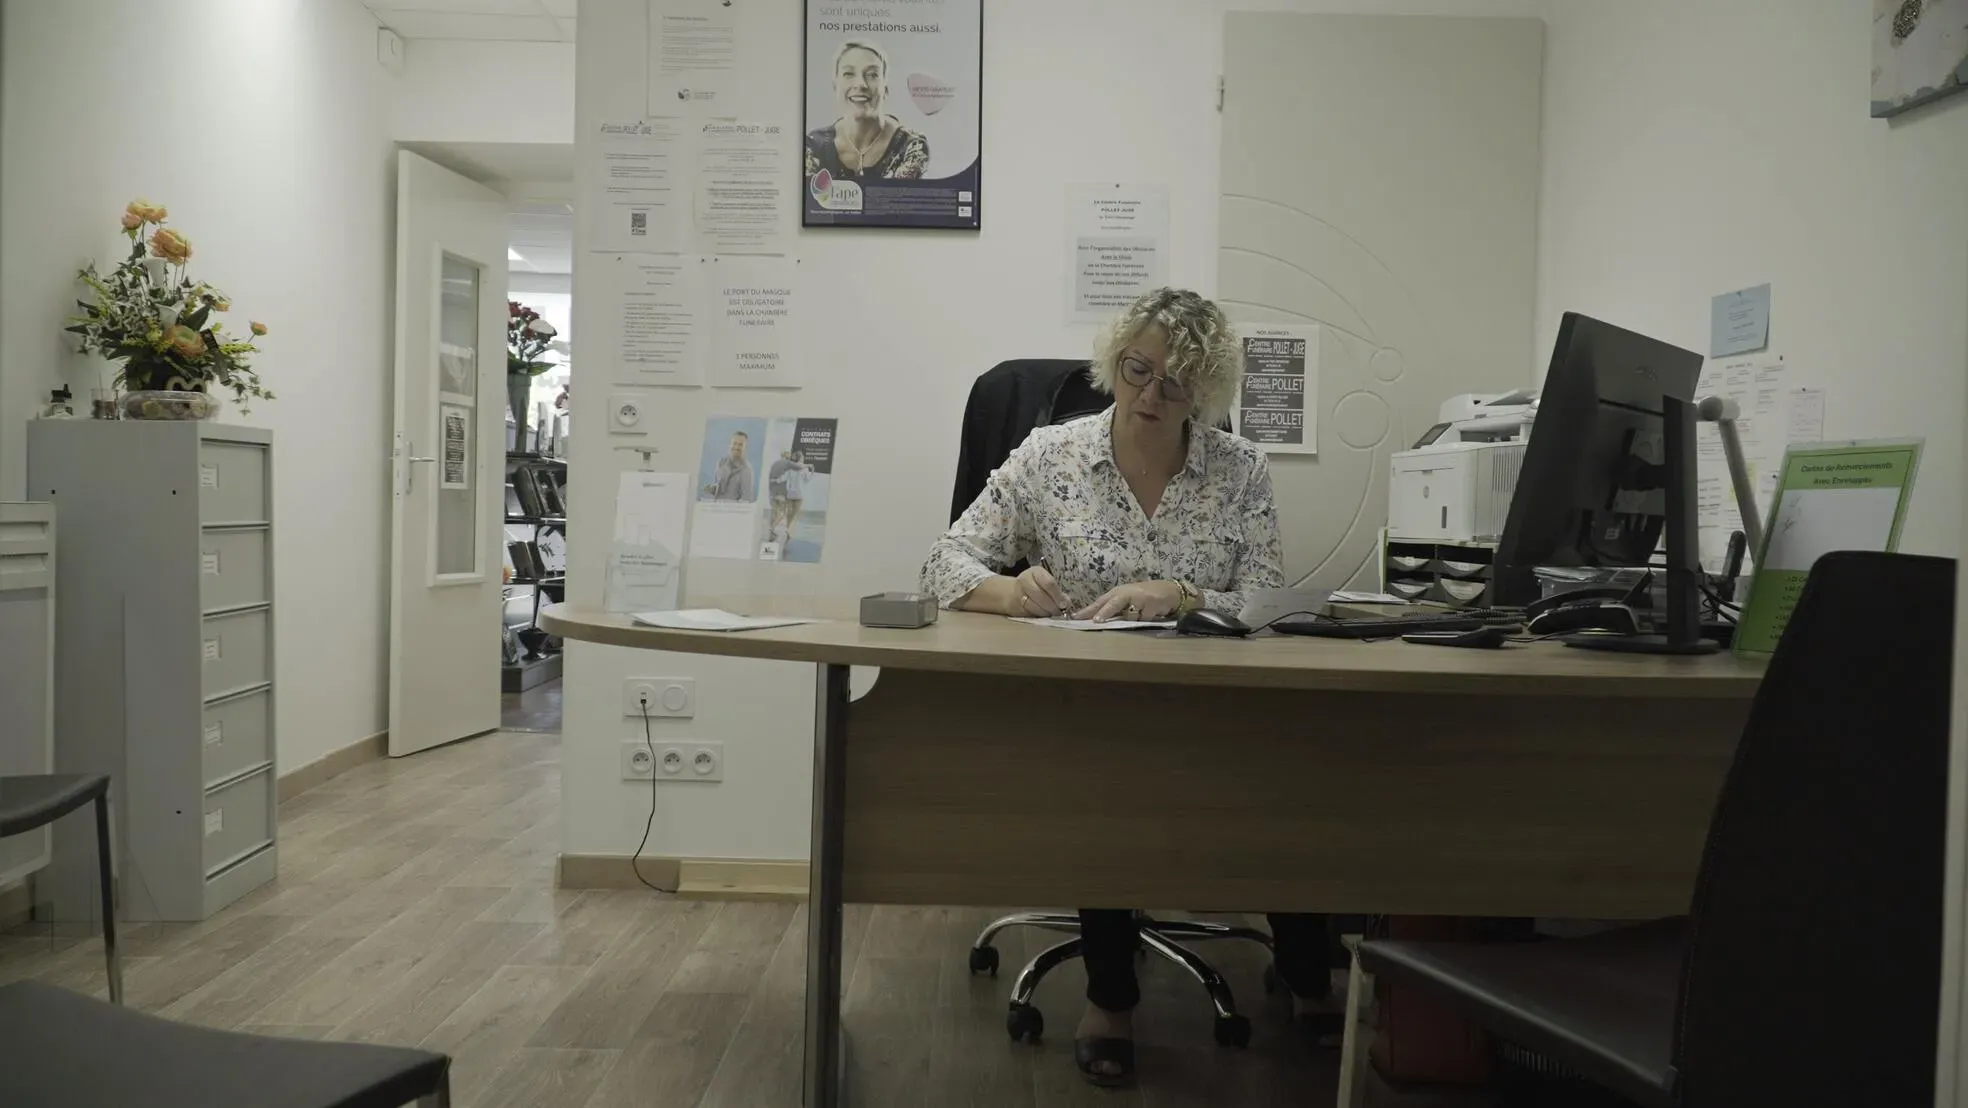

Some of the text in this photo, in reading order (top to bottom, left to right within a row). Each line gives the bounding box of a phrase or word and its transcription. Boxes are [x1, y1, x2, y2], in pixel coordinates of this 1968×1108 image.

[819, 21, 942, 33] nos prestations aussi.
[726, 308, 745, 316] DANS
[755, 308, 788, 316] CHAMBRE
[1272, 341, 1290, 354] POLLET
[741, 352, 780, 360] PERSONNES
[1272, 378, 1304, 391] POLLET
[1270, 413, 1303, 426] POLLET
